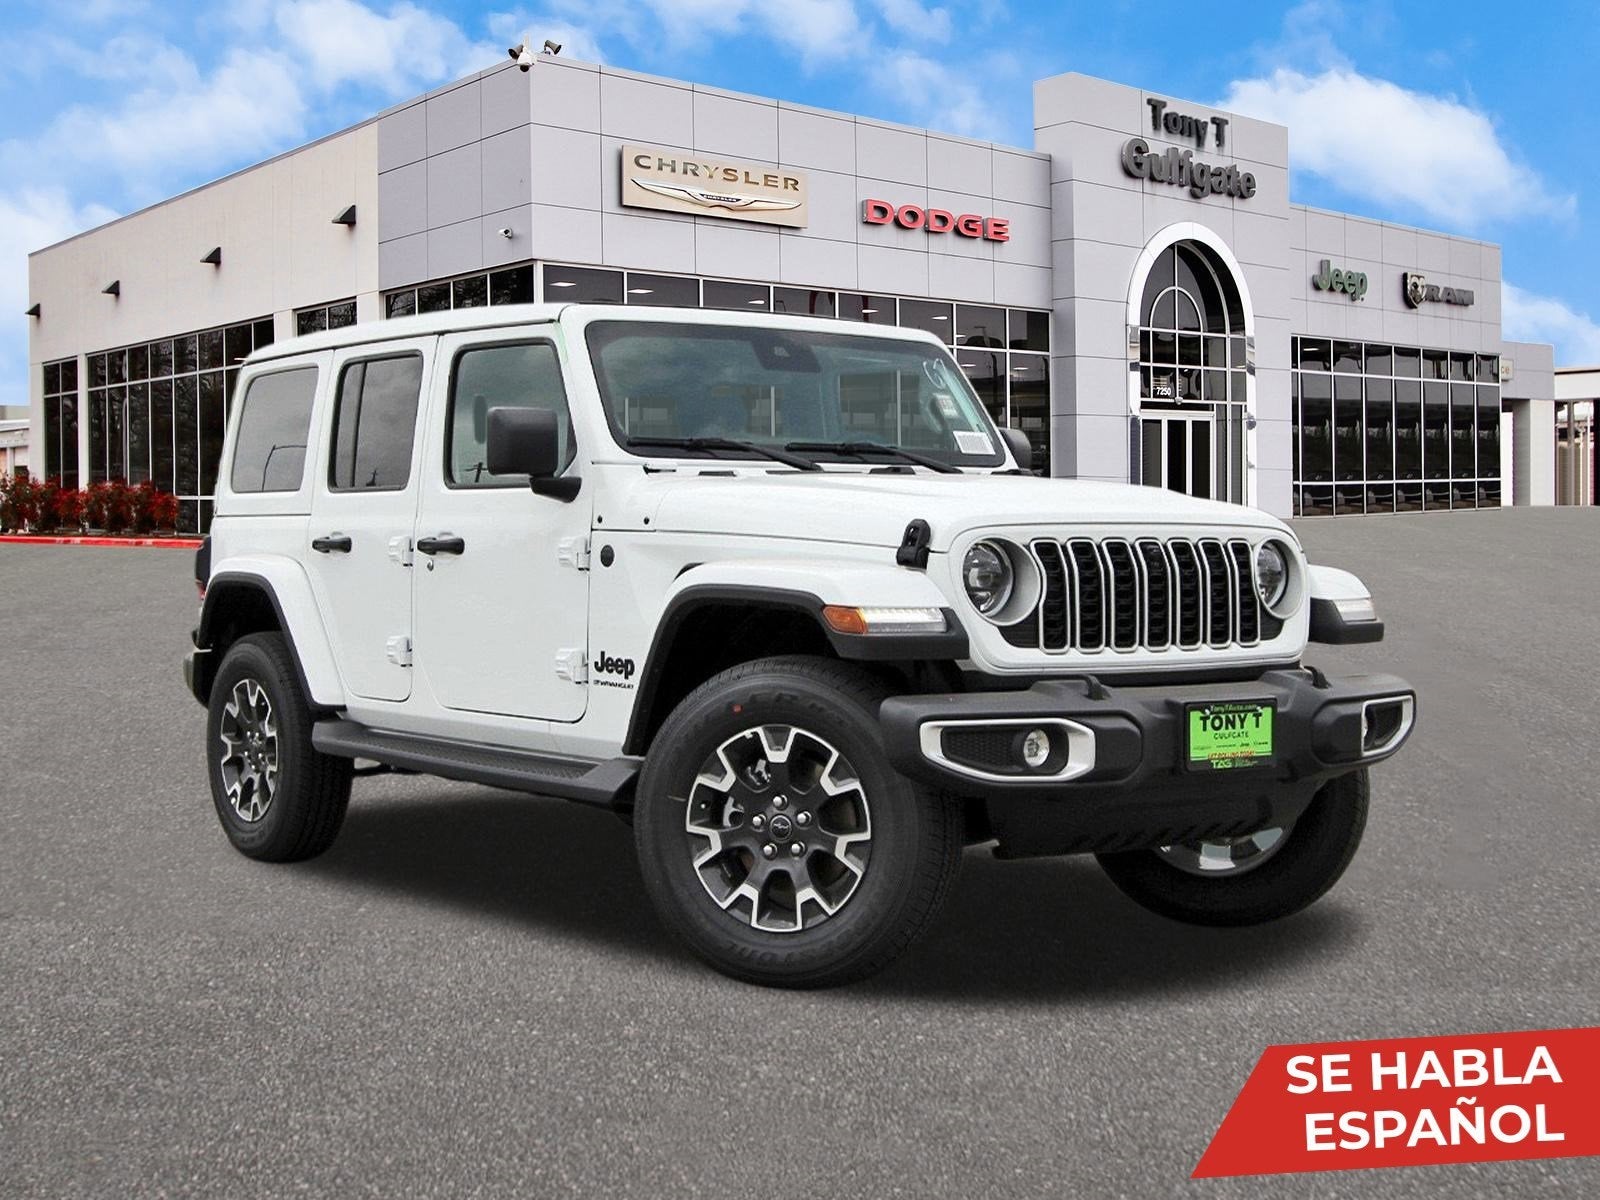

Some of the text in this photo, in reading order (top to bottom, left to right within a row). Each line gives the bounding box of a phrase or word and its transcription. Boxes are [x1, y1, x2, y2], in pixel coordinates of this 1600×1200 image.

[1146, 98, 1229, 147] Tony T
[634, 154, 800, 192] CHRYSLER
[1121, 138, 1257, 199] Gulfgate
[862, 198, 1011, 242] DODGE
[1312, 259, 1368, 301] Jeep
[1424, 284, 1475, 306] RAM
[1156, 387, 1171, 396] 7250
[594, 650, 635, 680] Jeep
[1200, 712, 1262, 732] TONY T
